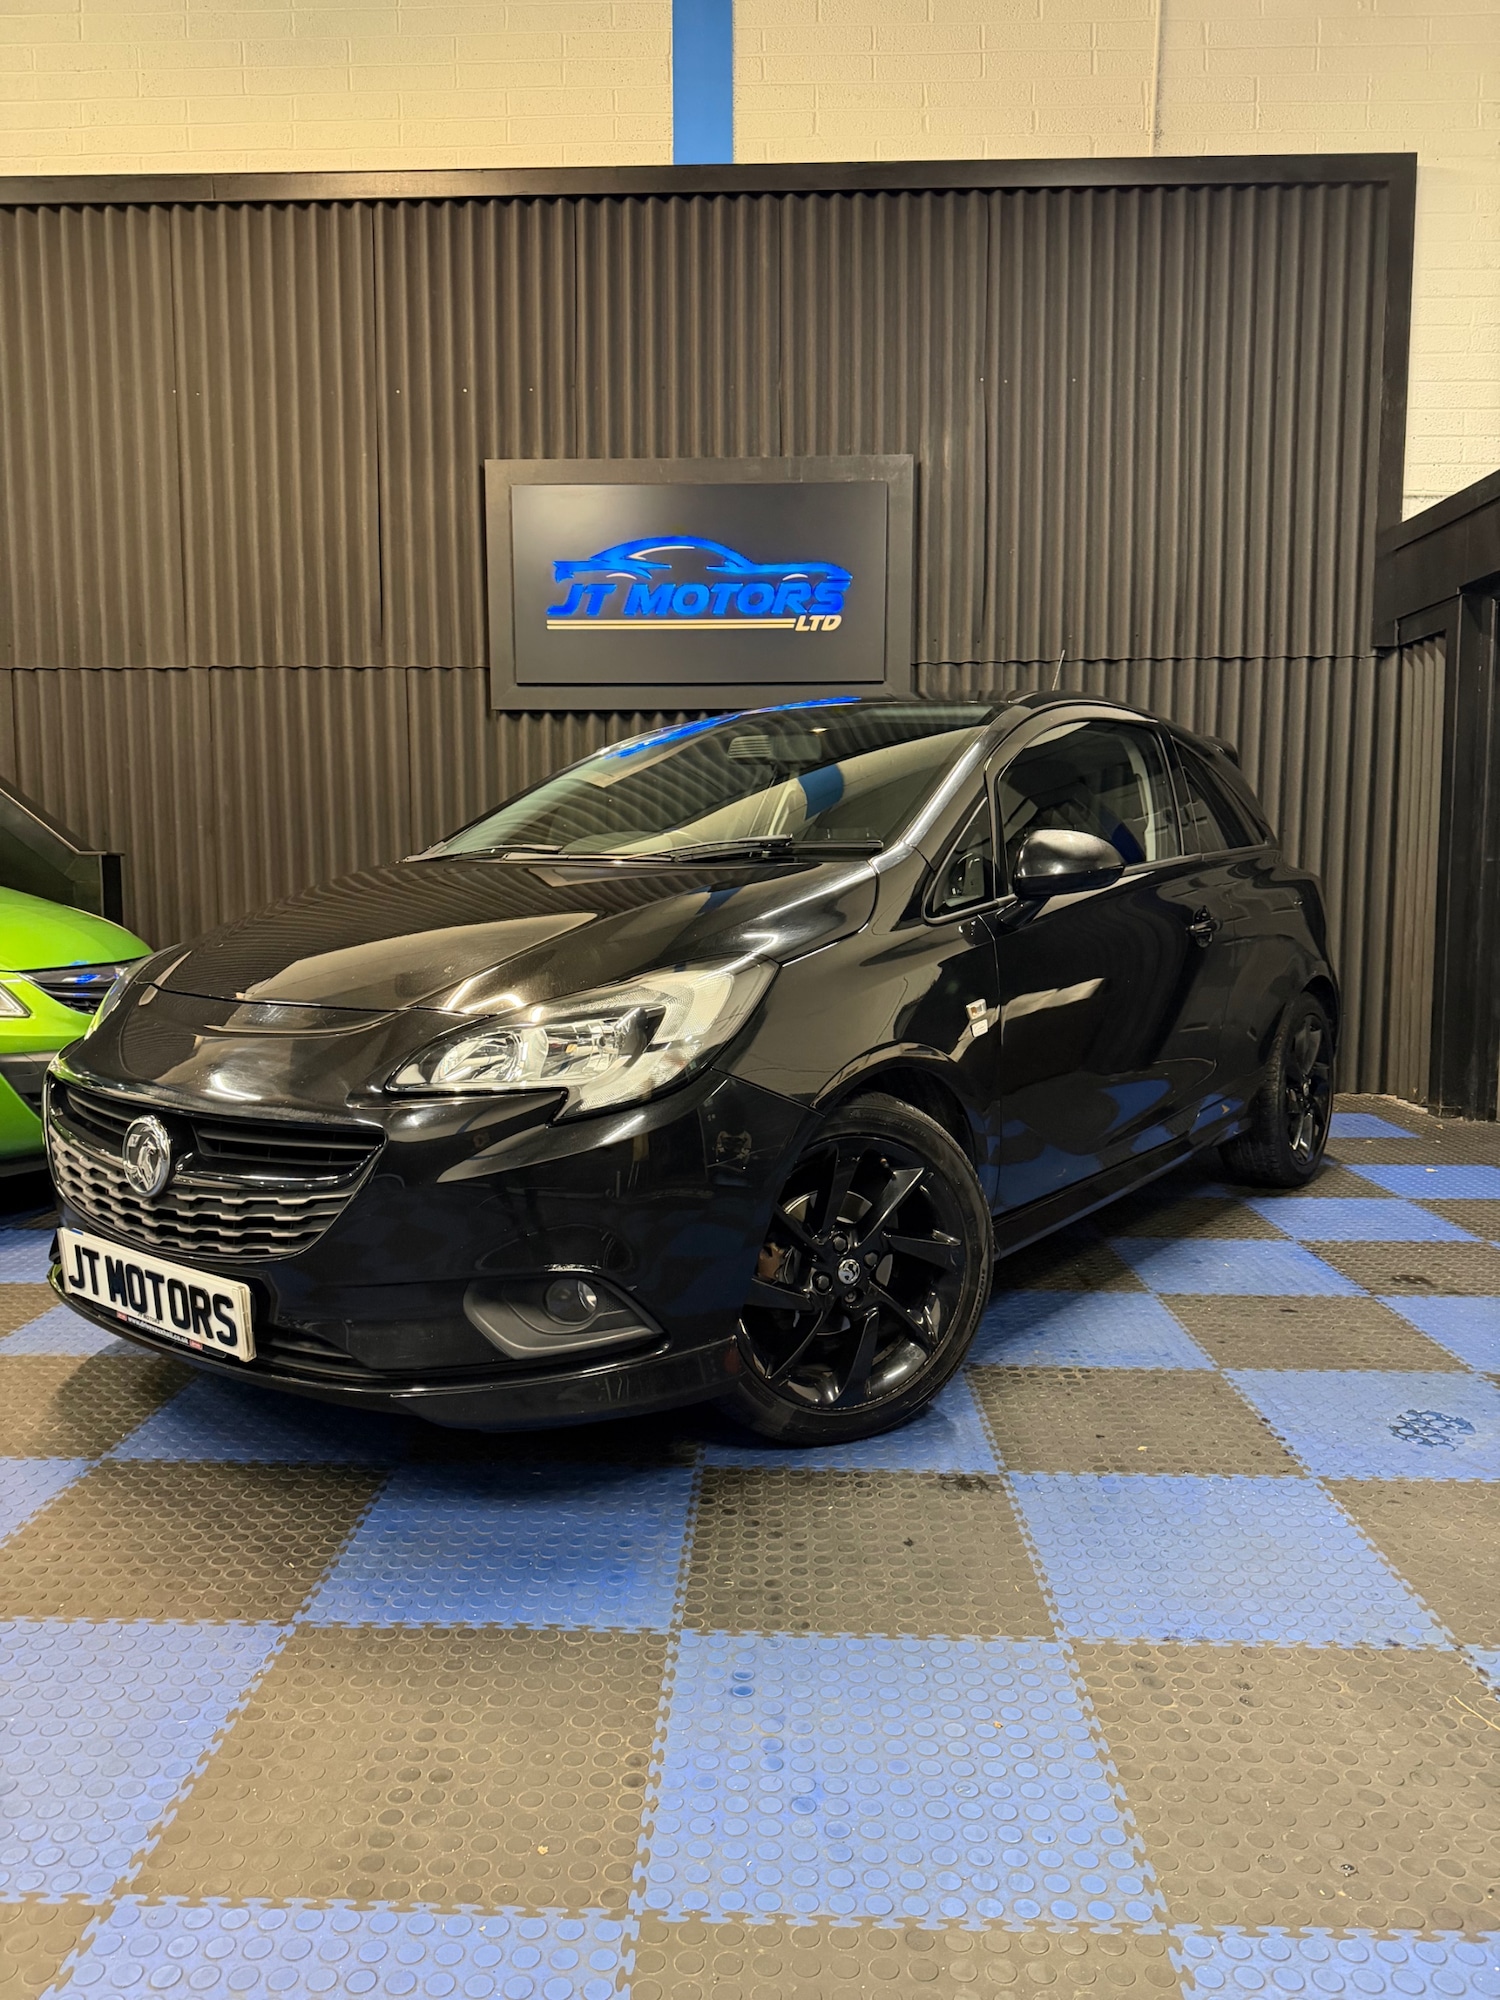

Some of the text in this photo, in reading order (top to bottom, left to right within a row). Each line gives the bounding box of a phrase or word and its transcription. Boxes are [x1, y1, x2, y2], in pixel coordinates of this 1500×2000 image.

[546, 582, 850, 616] JT MOTORS
[795, 615, 842, 631] LTD
[68, 1244, 238, 1347] JT MOTORS
